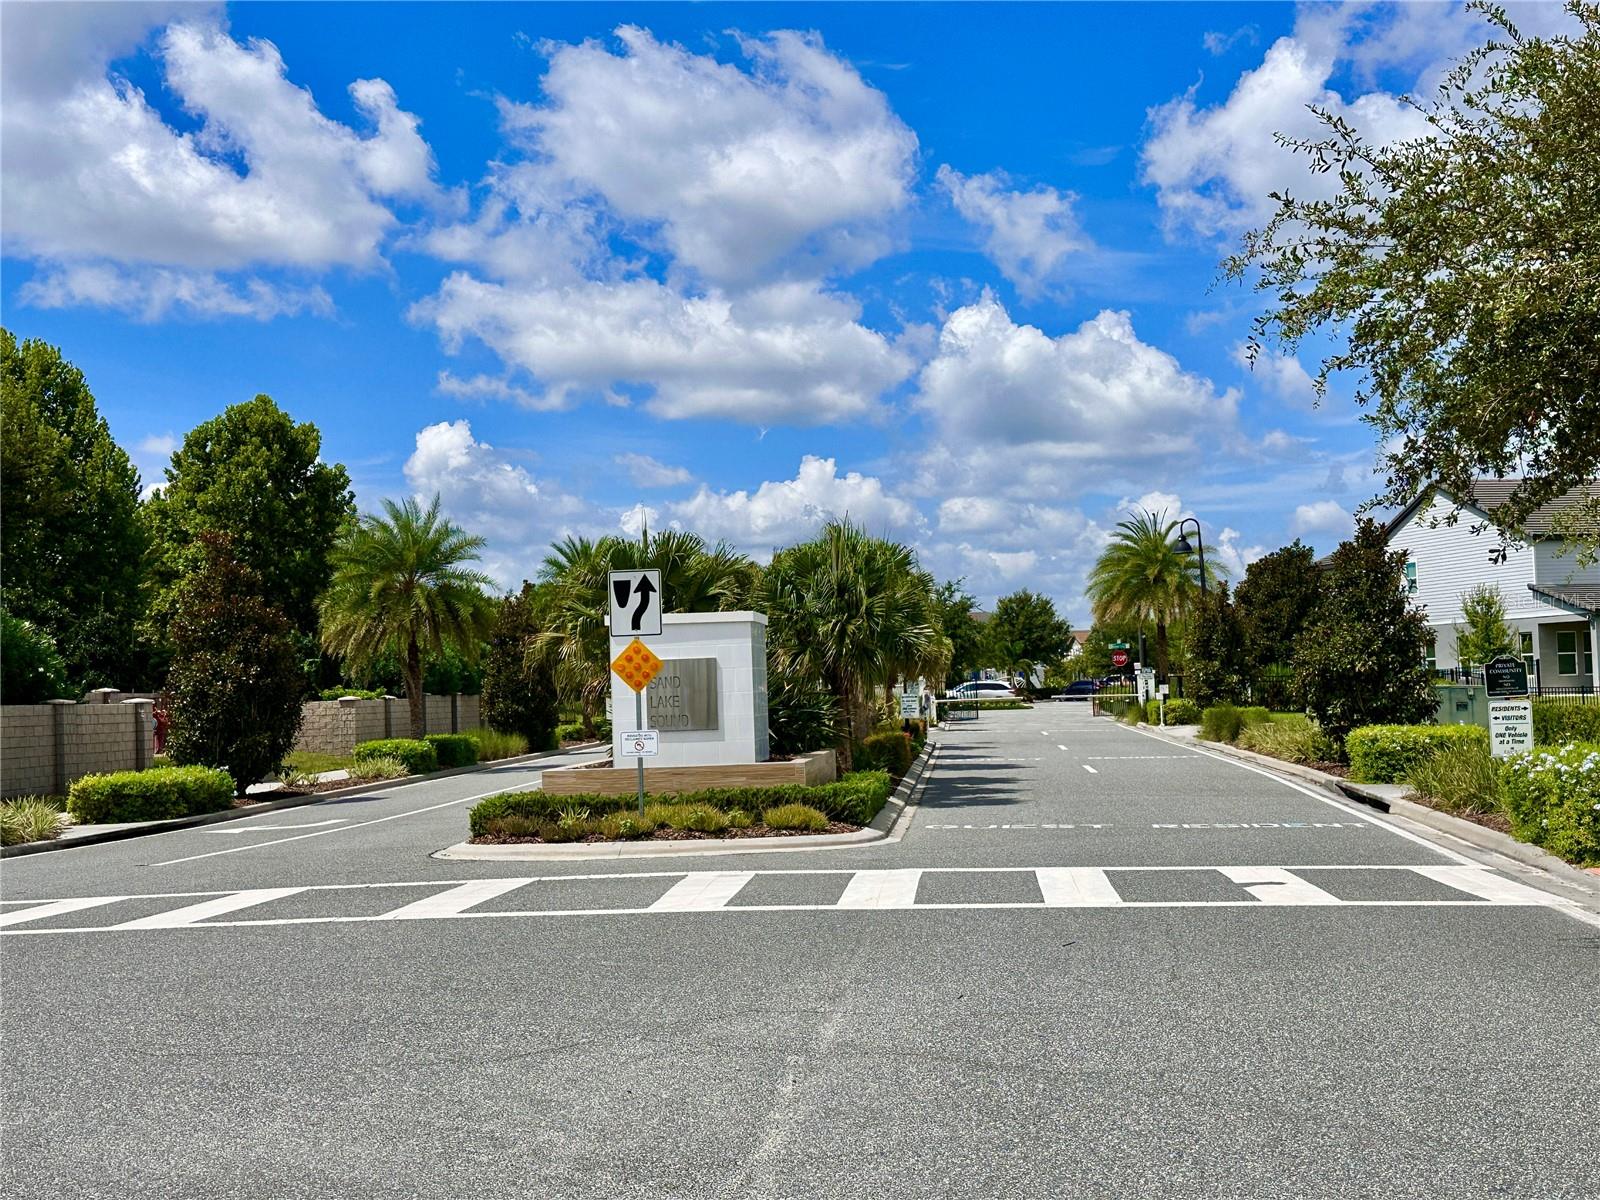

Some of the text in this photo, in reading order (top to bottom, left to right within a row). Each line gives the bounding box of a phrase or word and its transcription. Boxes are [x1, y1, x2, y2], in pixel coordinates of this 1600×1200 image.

[650, 676, 681, 689] SAND
[650, 695, 681, 709] LAKE
[650, 714, 689, 728] SOUND
